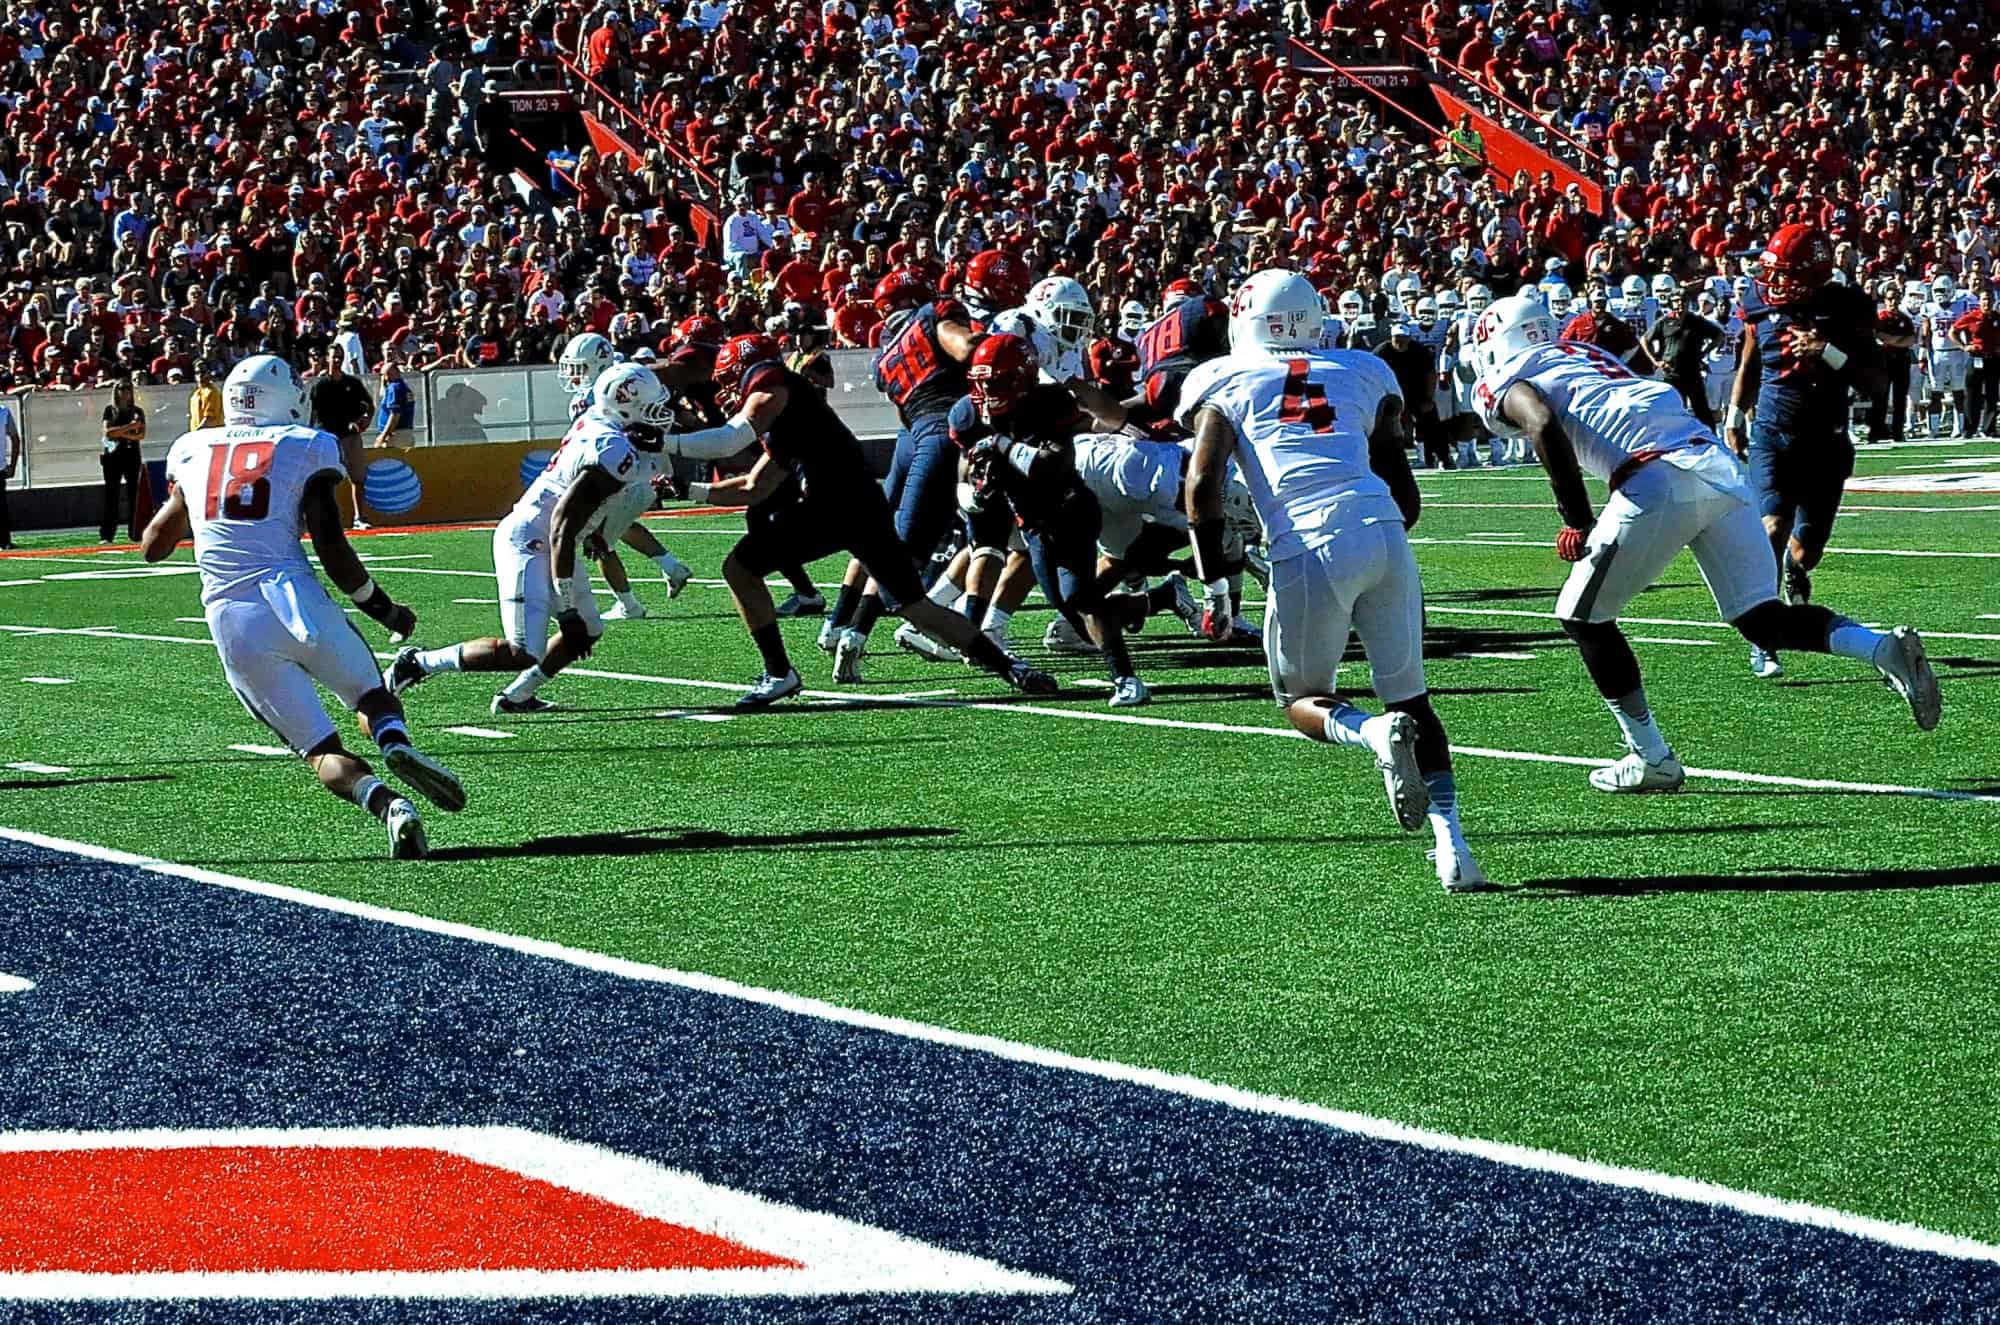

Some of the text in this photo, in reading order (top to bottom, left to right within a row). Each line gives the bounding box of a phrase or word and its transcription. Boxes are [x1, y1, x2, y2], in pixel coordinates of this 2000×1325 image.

[535, 98, 549, 111] 20
[1140, 308, 1181, 369] 78
[1289, 323, 1297, 339] 4
[245, 395, 255, 409] 18
[1279, 358, 1337, 433] 4
[617, 454, 633, 474] 8
[205, 441, 275, 521] 18
